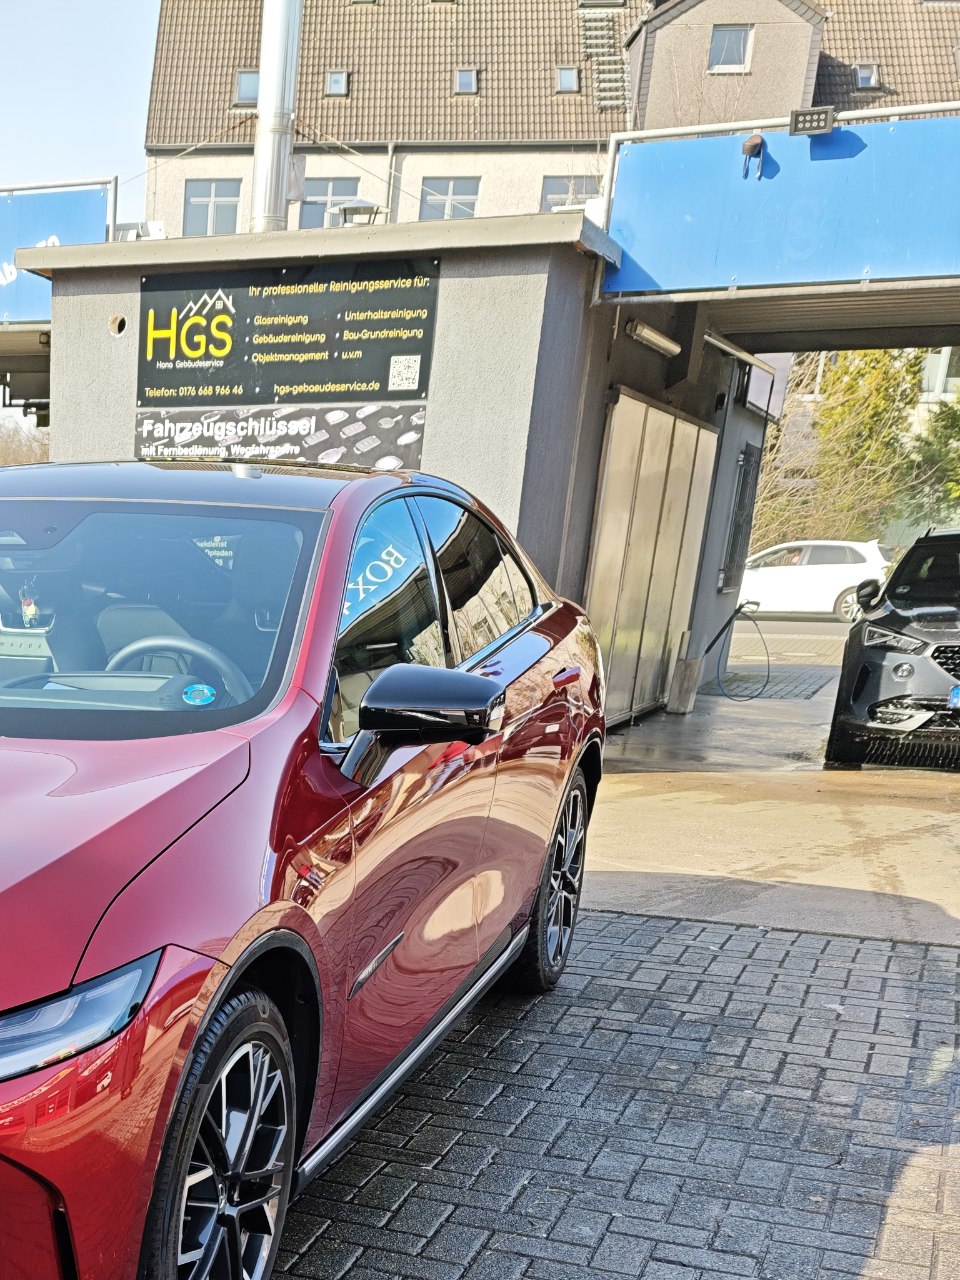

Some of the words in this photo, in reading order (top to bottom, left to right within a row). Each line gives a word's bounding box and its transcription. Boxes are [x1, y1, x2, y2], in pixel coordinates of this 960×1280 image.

[248, 285, 261, 297] Ihr
[262, 281, 328, 298] professioneller
[329, 277, 412, 293] Reinigungsservice
[413, 275, 430, 287] für:
[253, 314, 309, 326] Glasreinigung
[344, 308, 428, 321] Unterhaltsreinigung
[146, 307, 233, 361] HGS
[252, 332, 326, 345] Gebäudereinigung
[343, 328, 423, 341] Bau-Grundreinigung
[175, 359, 224, 369] Gebäudeservice
[251, 350, 329, 364] Objektmanagement
[144, 386, 178, 398] Telefon:
[178, 386, 196, 396] 0176
[197, 385, 214, 396] 668
[215, 385, 230, 396] 966
[232, 384, 244, 395] 46
[273, 380, 380, 395] hgs-gebaeudeservice.de
[142, 415, 317, 441] Fahrzeugschlüssel
[141, 444, 156, 457] mit
[157, 444, 228, 458] Fernbedienung,
